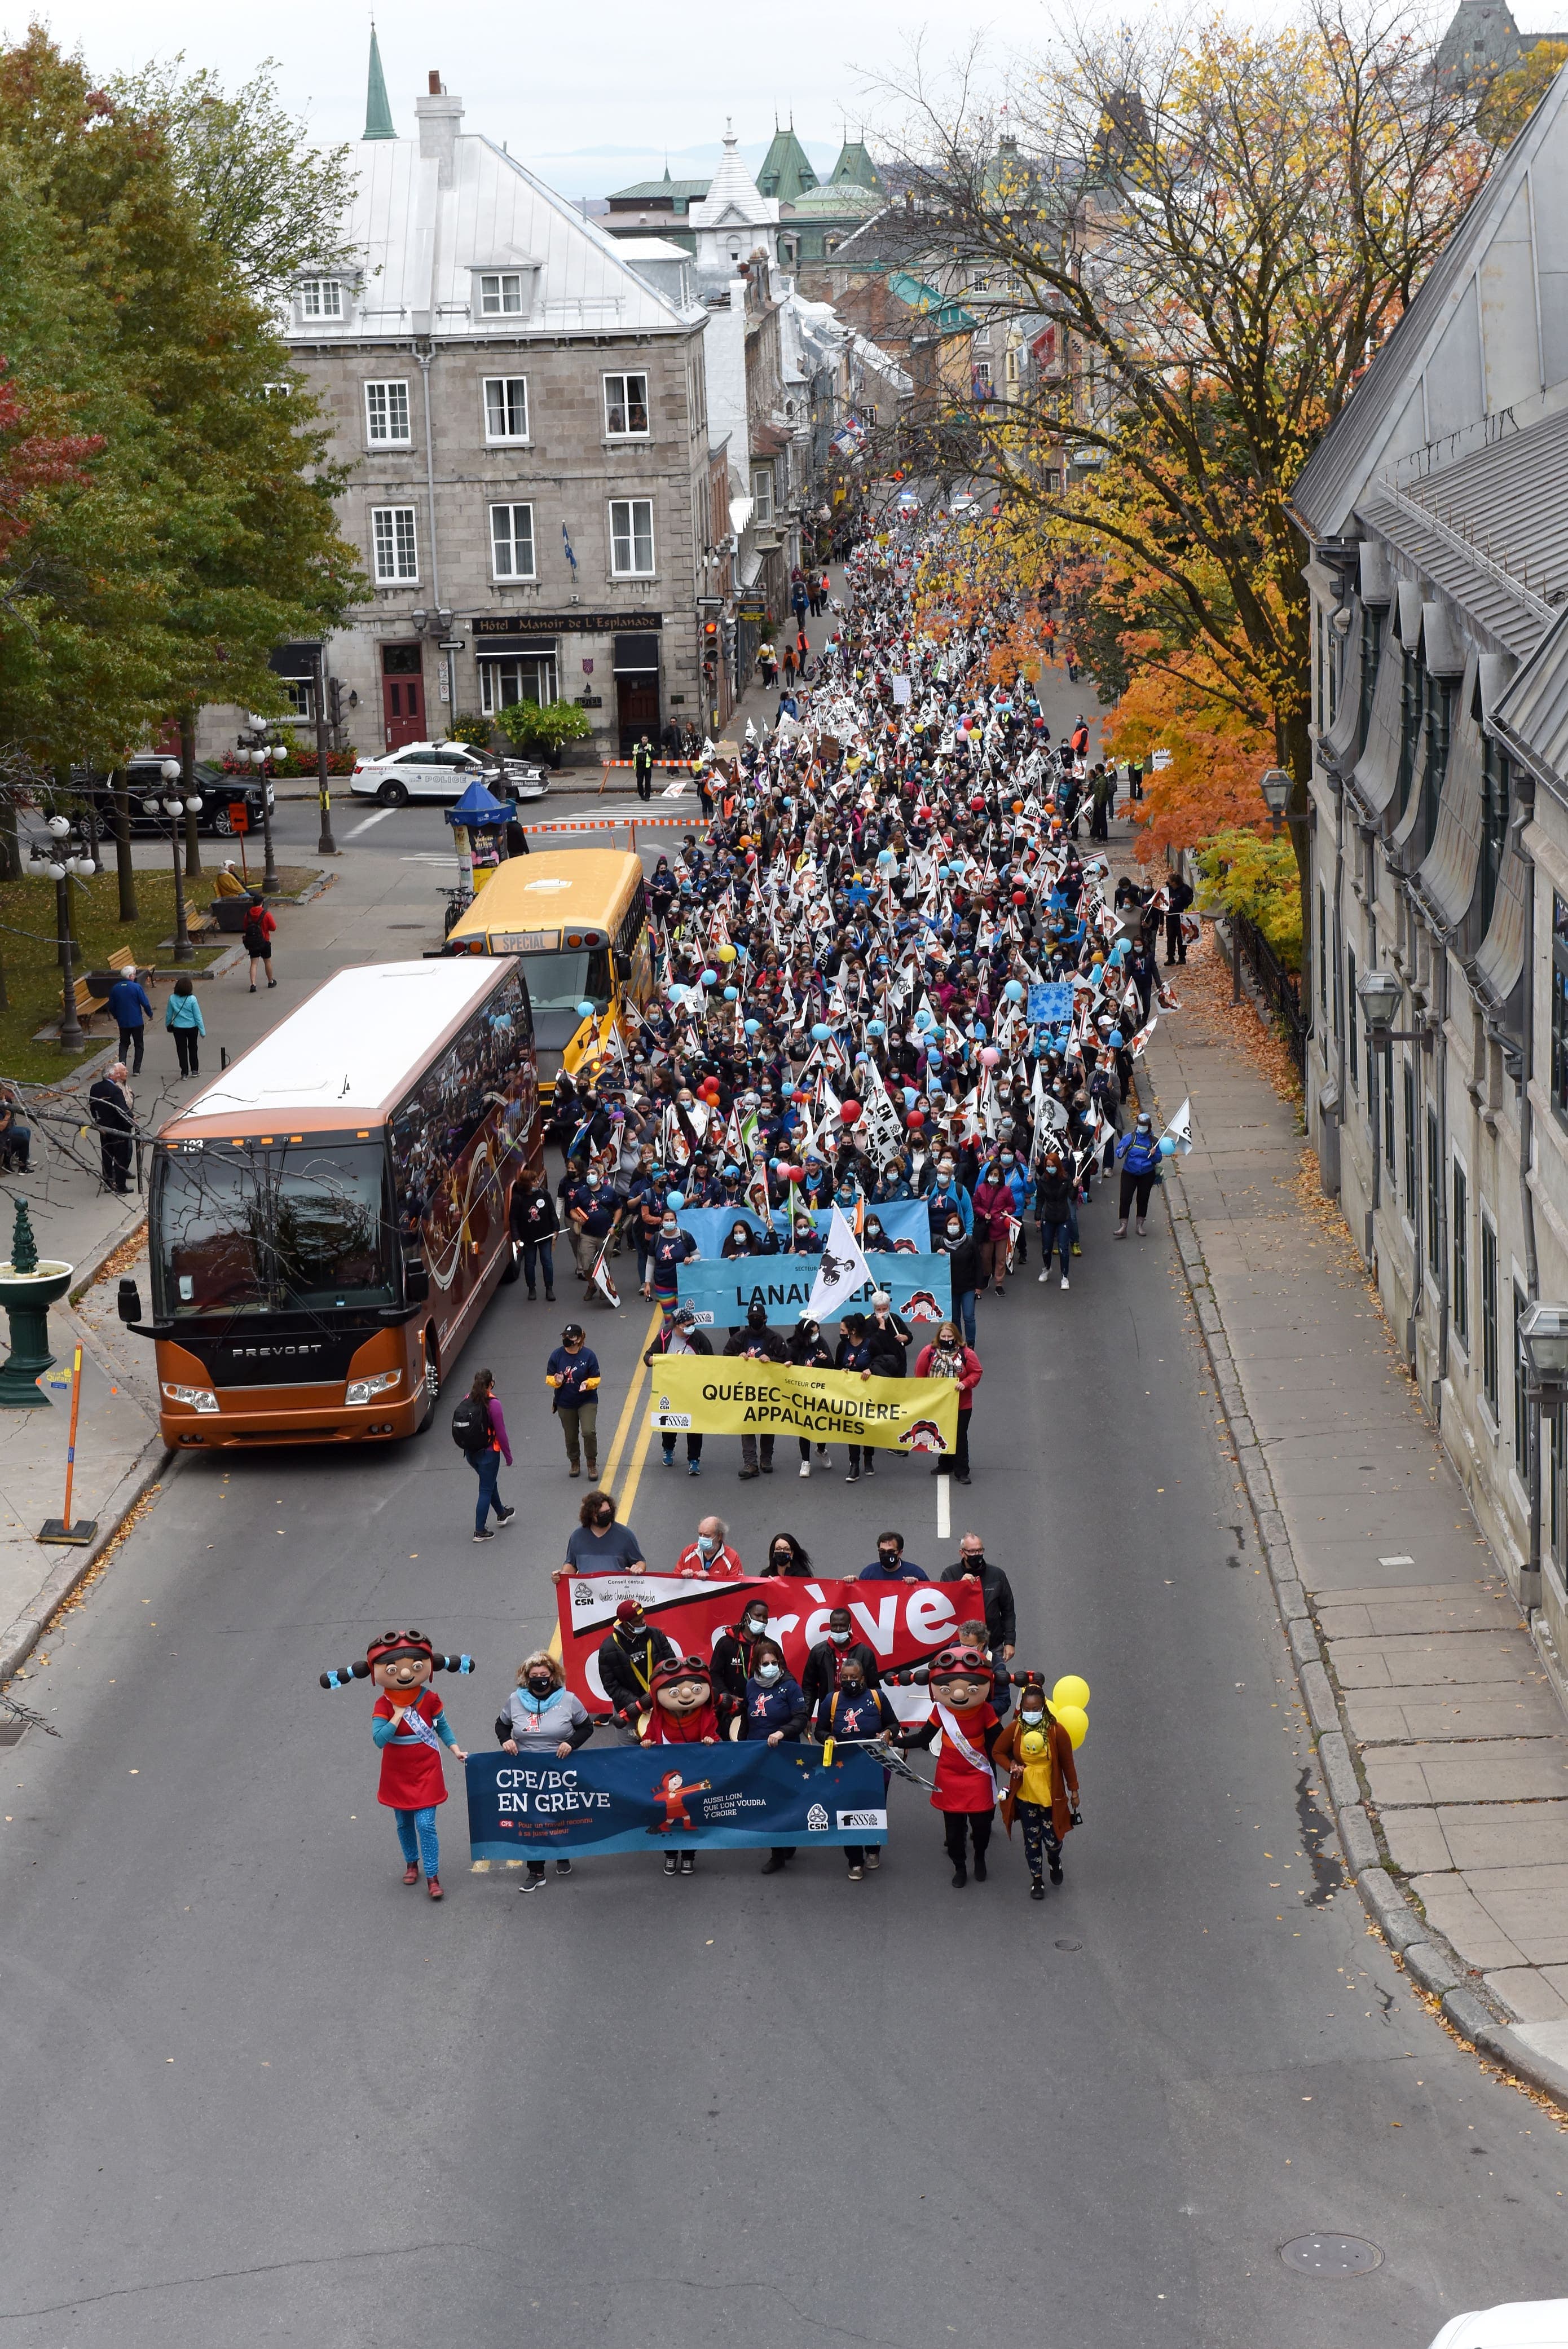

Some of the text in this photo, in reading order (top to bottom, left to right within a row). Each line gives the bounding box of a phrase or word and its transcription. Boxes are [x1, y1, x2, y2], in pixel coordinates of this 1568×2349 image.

[479, 616, 655, 632] Hôtel Manoir de L'Esplanade
[503, 935, 547, 951] SPECIAL
[877, 1103, 893, 1122] EN
[232, 1345, 321, 1358] PREVOST
[785, 1378, 826, 1390] SECTEUR CPE
[743, 1406, 865, 1435] APPALACHES
[496, 1769, 577, 1790] CPE/BC
[497, 1788, 611, 1812] EN GRÈVE
[703, 1792, 742, 1805] AUSSI LOIN
[703, 1804, 719, 1813] QUE
[736, 1799, 767, 1807] VOUDRA
[711, 1809, 737, 1818] CROIRE
[531, 1830, 548, 1838] juste
